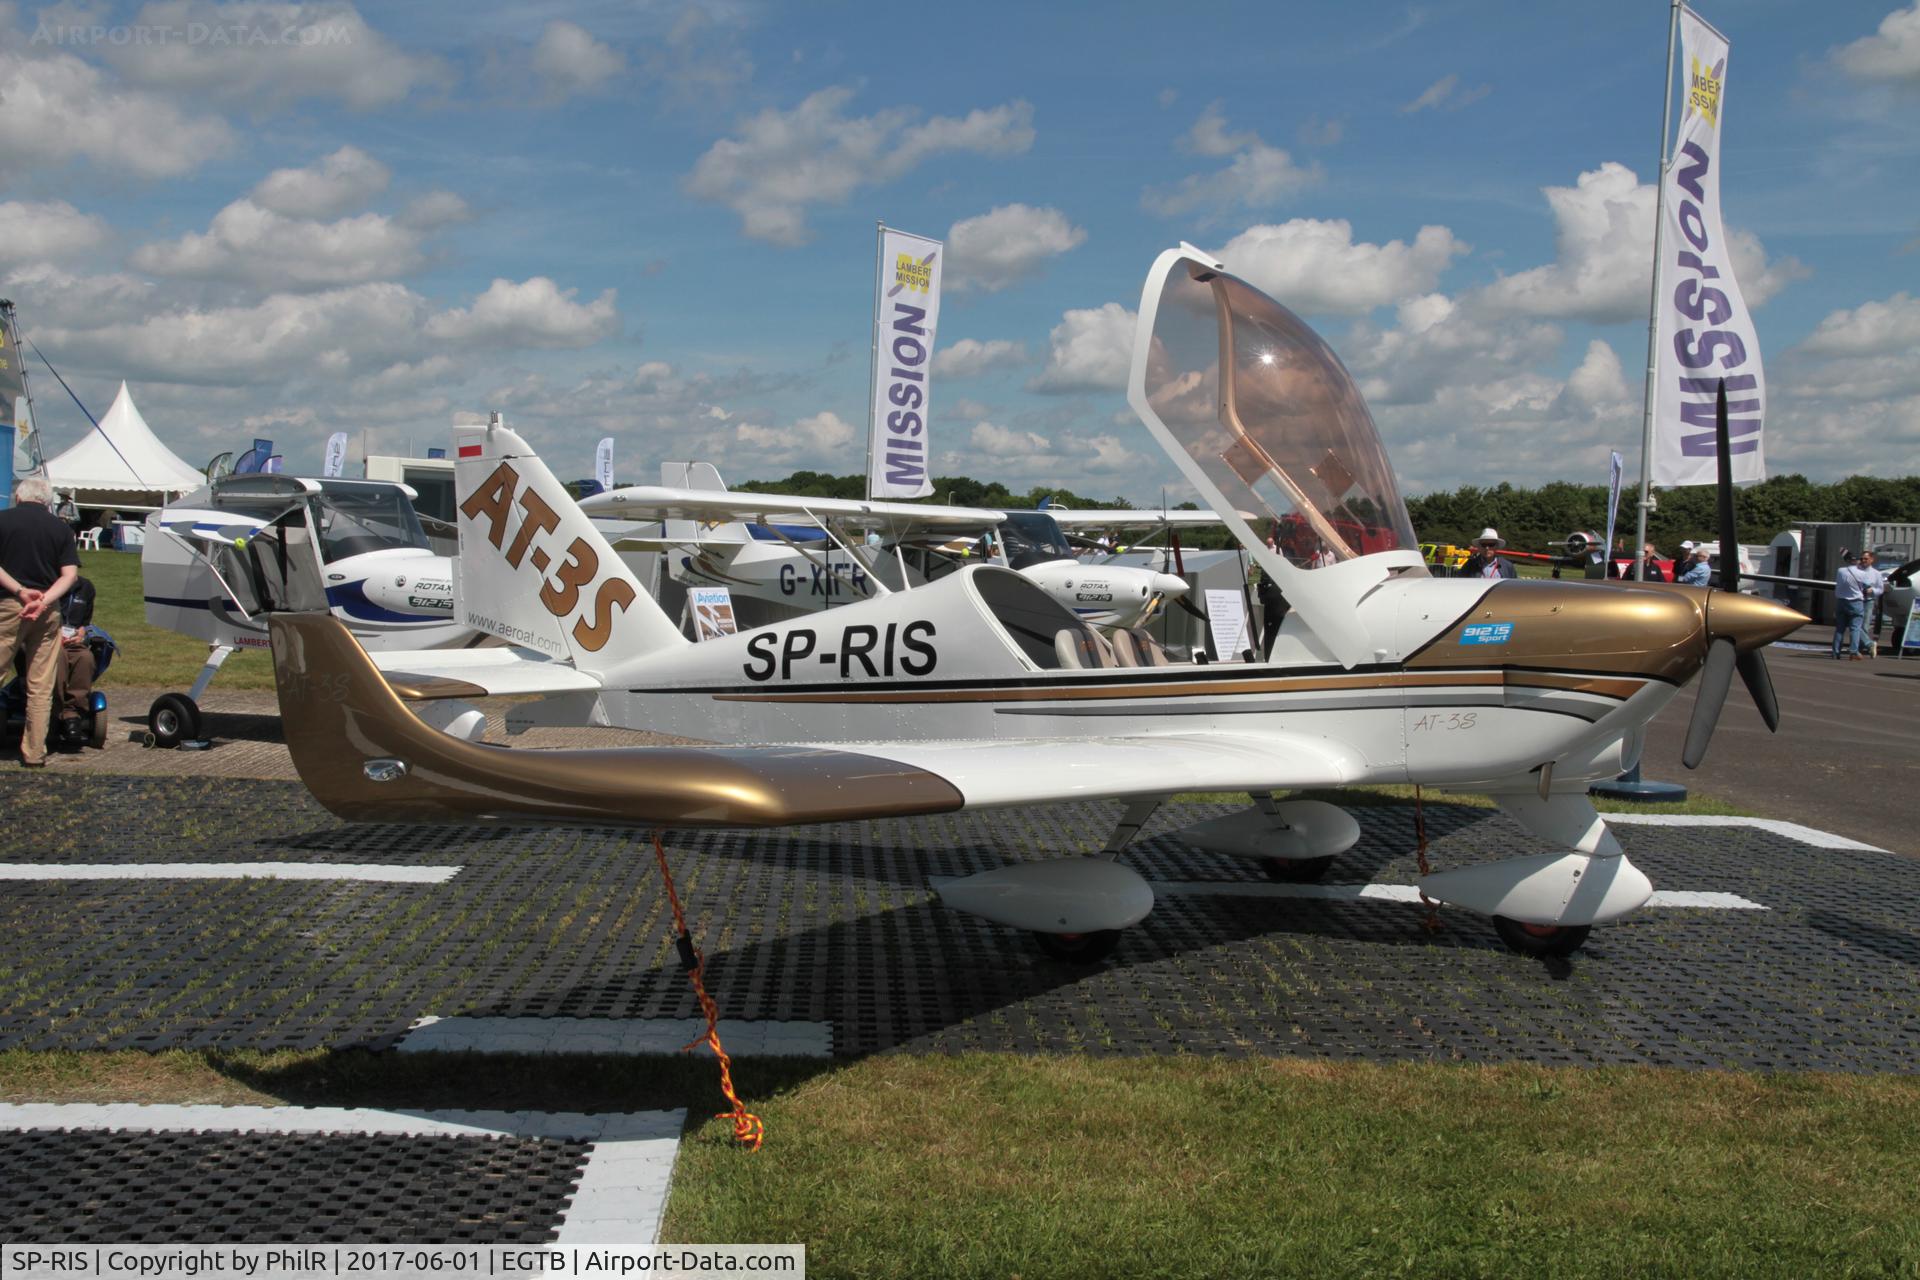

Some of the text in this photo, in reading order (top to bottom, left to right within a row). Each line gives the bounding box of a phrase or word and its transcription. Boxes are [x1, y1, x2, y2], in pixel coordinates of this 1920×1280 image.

[896, 259, 932, 278] LAMBERT
[896, 271, 930, 289] MISSION
[1674, 138, 1761, 457] MISSION
[886, 302, 927, 486] MISSION
[460, 461, 637, 652] AT-3S
[414, 582, 452, 591] ROTAX
[696, 592, 729, 603] Aviation
[468, 611, 562, 654] www.aeroat.com
[1464, 627, 1492, 636] 912
[743, 619, 937, 682] SP-RIS
[1412, 712, 1478, 732] AT-3S
